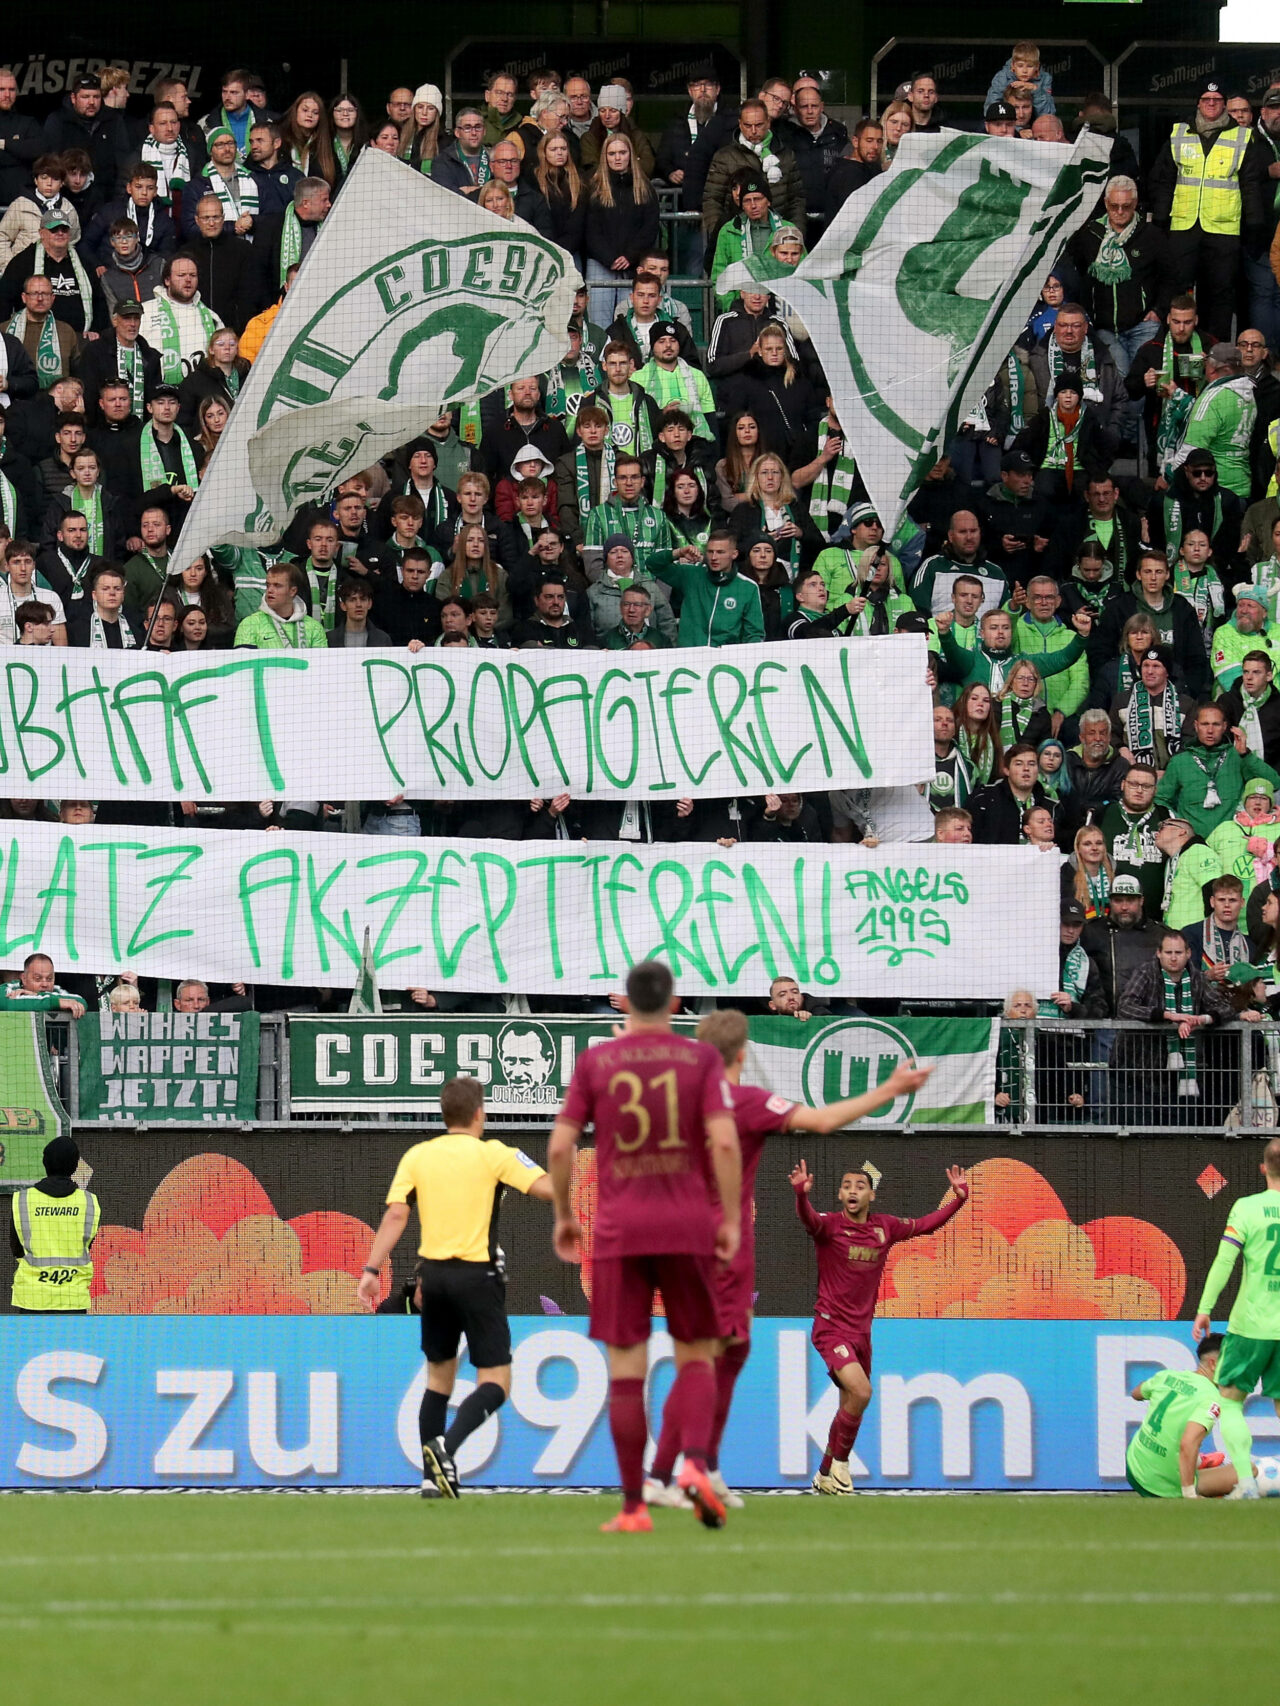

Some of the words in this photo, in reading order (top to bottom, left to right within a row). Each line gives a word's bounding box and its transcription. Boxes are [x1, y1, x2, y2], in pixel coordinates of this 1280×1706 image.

[361, 646, 873, 793] PROPAGIEREN
[845, 866, 969, 904] ANGELS
[238, 848, 841, 992] AKZEPTIEREN!
[855, 905, 951, 945] 1995
[99, 1012, 242, 1041] WAHRES
[100, 1045, 239, 1076] WAPPEN
[315, 1033, 493, 1086] COES
[99, 1078, 238, 1109] JETZT!
[608, 1068, 687, 1153] 31
[34, 1206, 80, 1217] STEWARD
[15, 1350, 108, 1479] S
[153, 1369, 339, 1476] zu
[396, 1329, 678, 1479] 69
[777, 1329, 1034, 1477] km
[1148, 1390, 1178, 1436] 4
